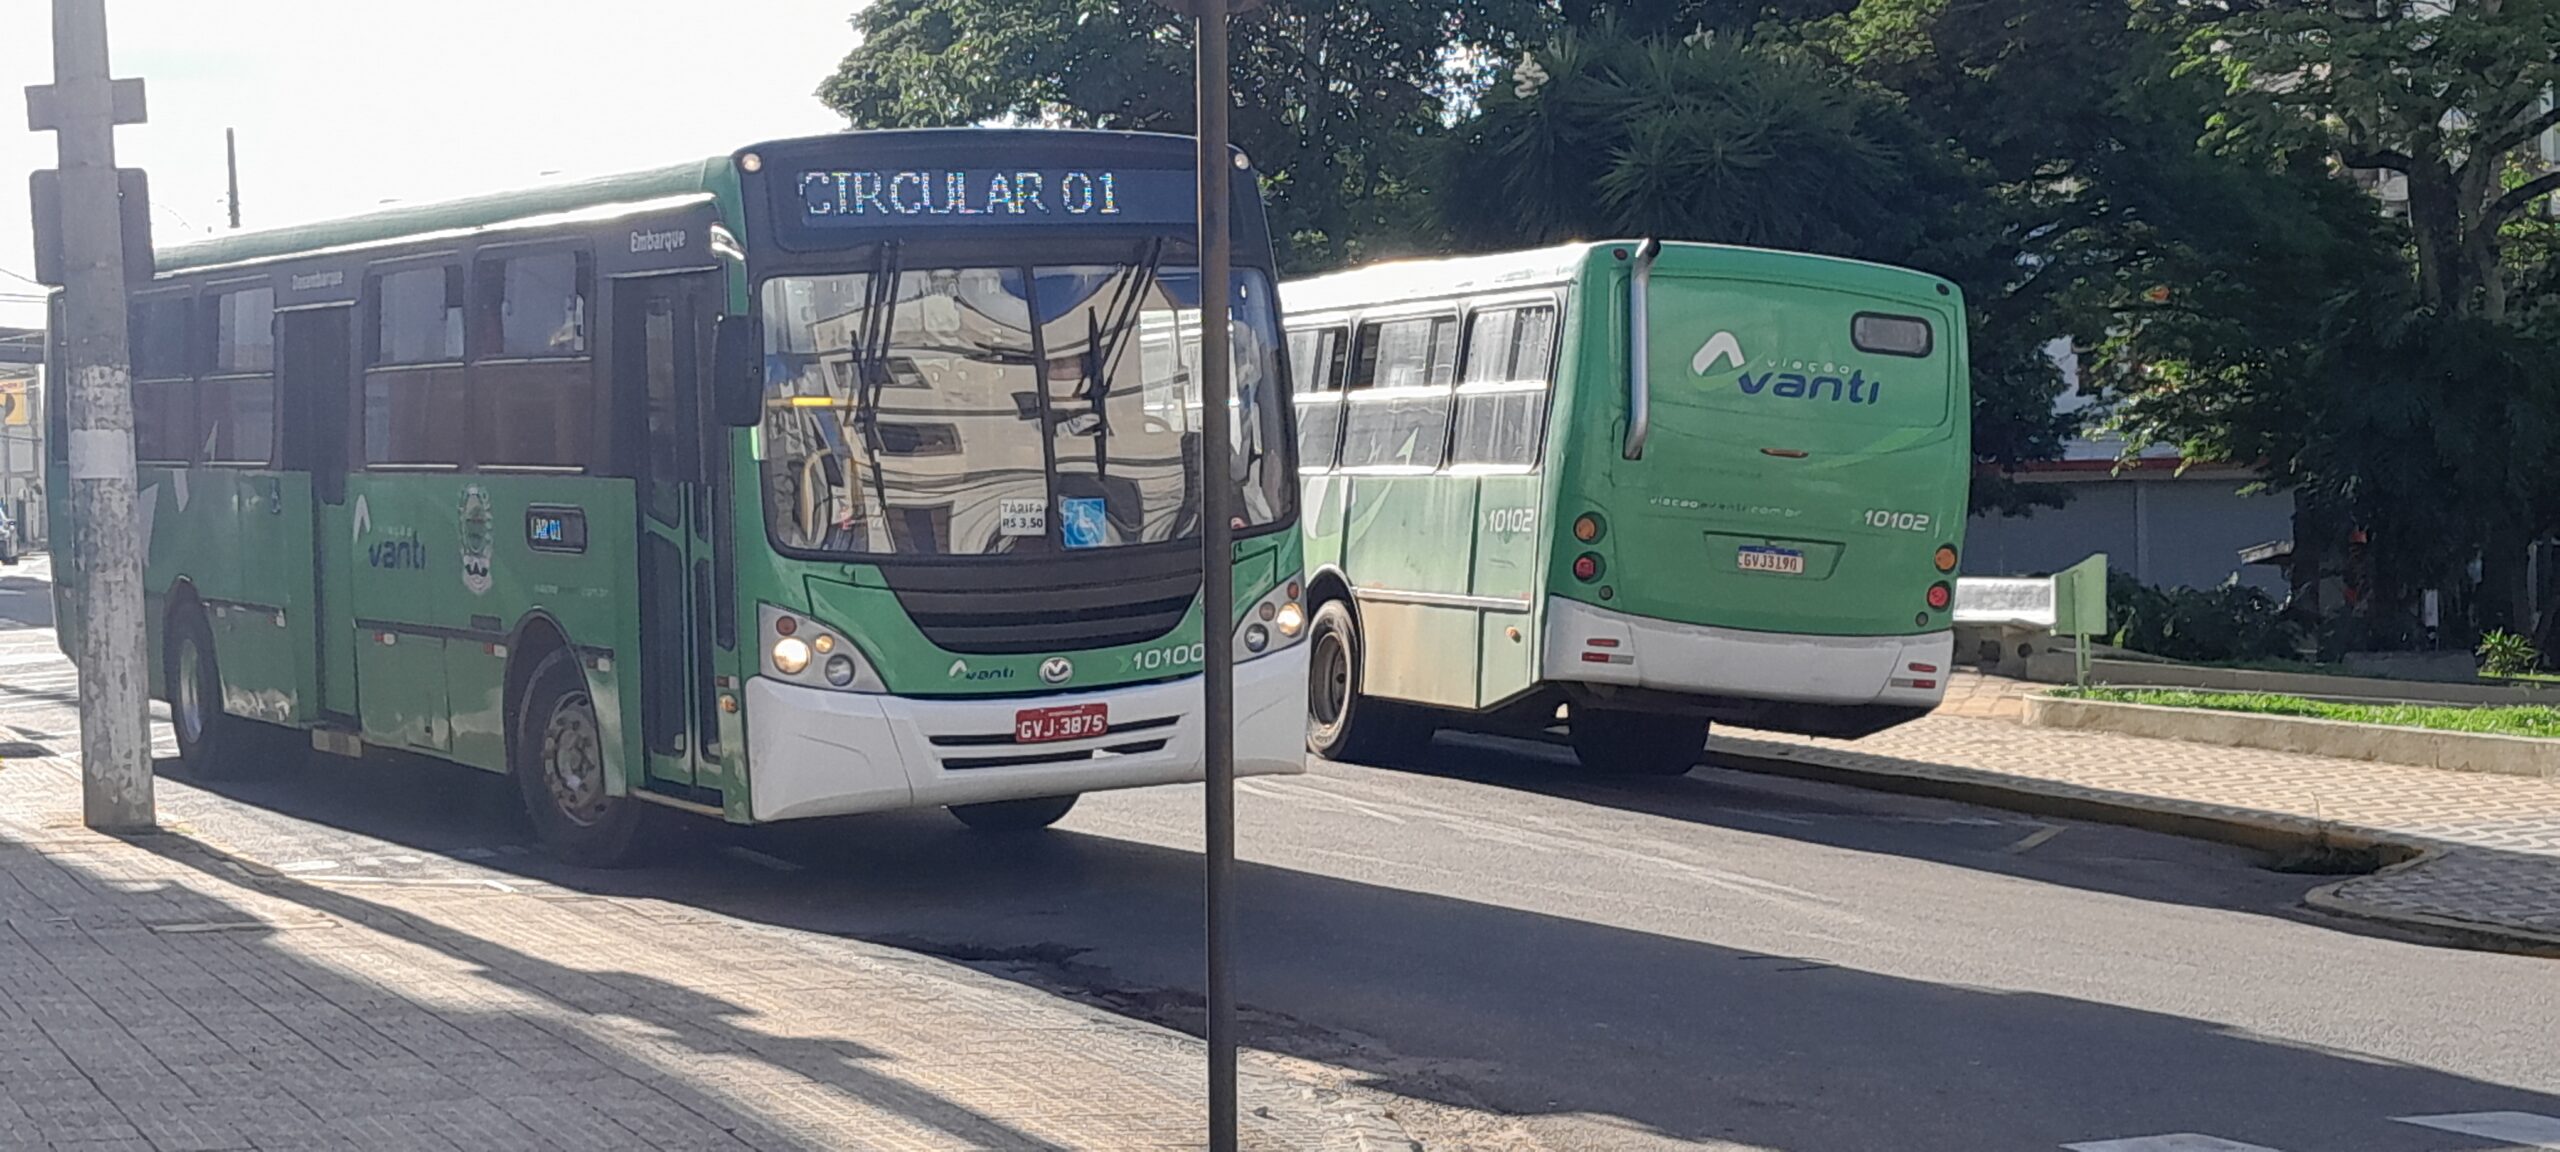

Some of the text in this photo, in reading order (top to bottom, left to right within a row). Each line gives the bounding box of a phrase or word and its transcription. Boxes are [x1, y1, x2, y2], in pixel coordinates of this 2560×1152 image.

[800, 172, 1121, 214] CIRCULAR 01
[630, 229, 686, 253] Embarque
[1489, 507, 1535, 532] 10102
[1864, 509, 1930, 531] 10102
[1133, 642, 1205, 671] 10100
